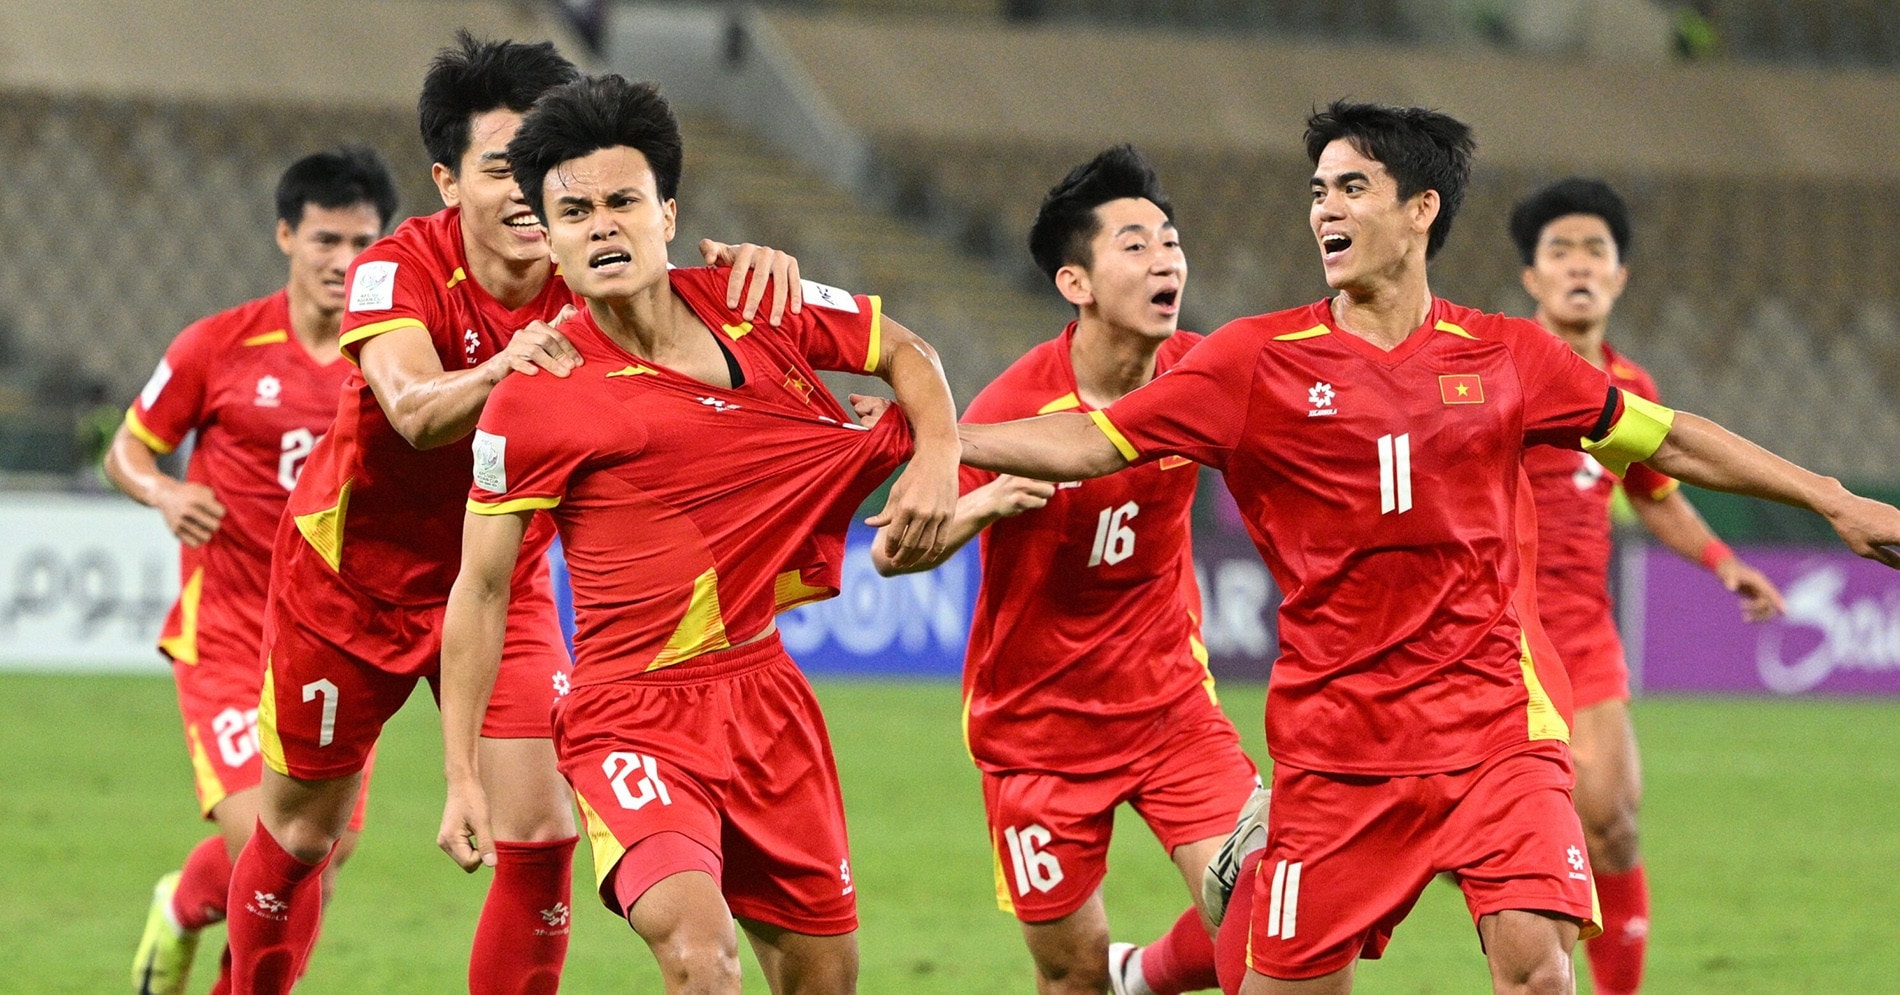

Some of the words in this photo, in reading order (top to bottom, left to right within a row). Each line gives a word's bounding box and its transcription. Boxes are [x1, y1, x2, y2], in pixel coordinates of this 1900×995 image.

[277, 426, 326, 492] 2
[1377, 432, 1413, 515] 11
[1087, 500, 1140, 568] 16
[302, 678, 339, 745] 7
[601, 751, 673, 811] 21
[1004, 824, 1064, 897] 16
[1267, 859, 1303, 940] 11
